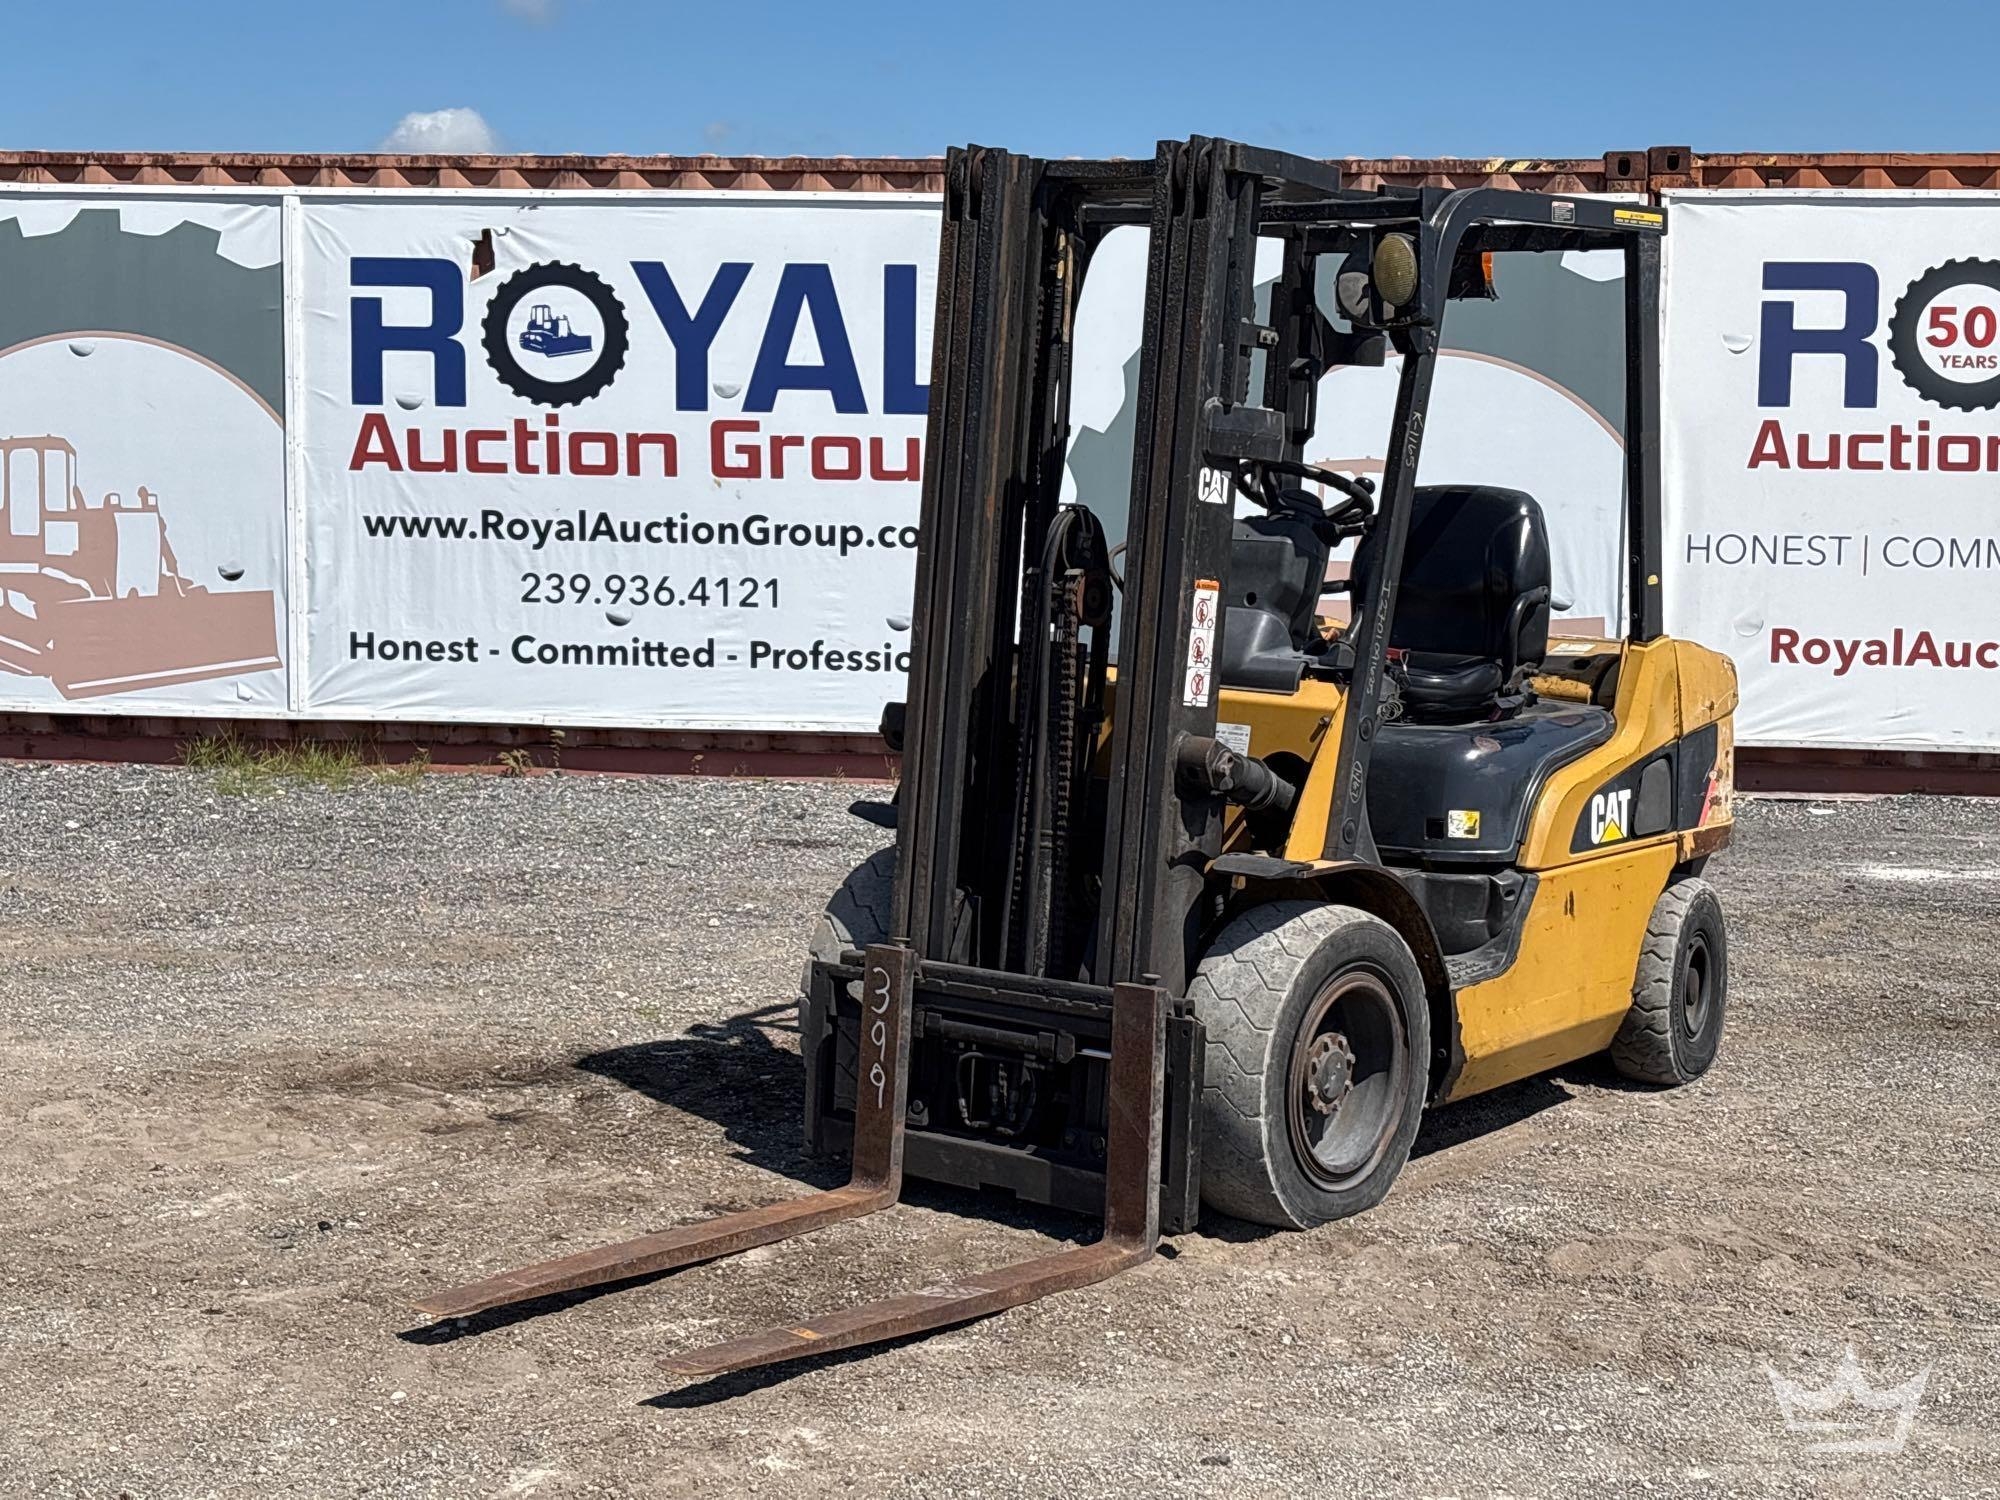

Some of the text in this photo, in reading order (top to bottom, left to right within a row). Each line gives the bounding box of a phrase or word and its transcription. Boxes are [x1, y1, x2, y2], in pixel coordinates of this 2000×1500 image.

[350, 257, 928, 416] ROYAL
[1925, 305, 1997, 349] 50
[1939, 354, 1998, 369] YEARS
[349, 412, 921, 482] Auction Grou
[1198, 467, 1231, 504] CAT
[1686, 533, 1852, 566] HONEST
[520, 572, 779, 609] 239.936.4121
[349, 631, 479, 663] Honest
[511, 634, 715, 669] Committed
[1770, 628, 2000, 677] RoyalAuc
[1591, 789, 1631, 844] CAT
[870, 967, 890, 1108] 399
